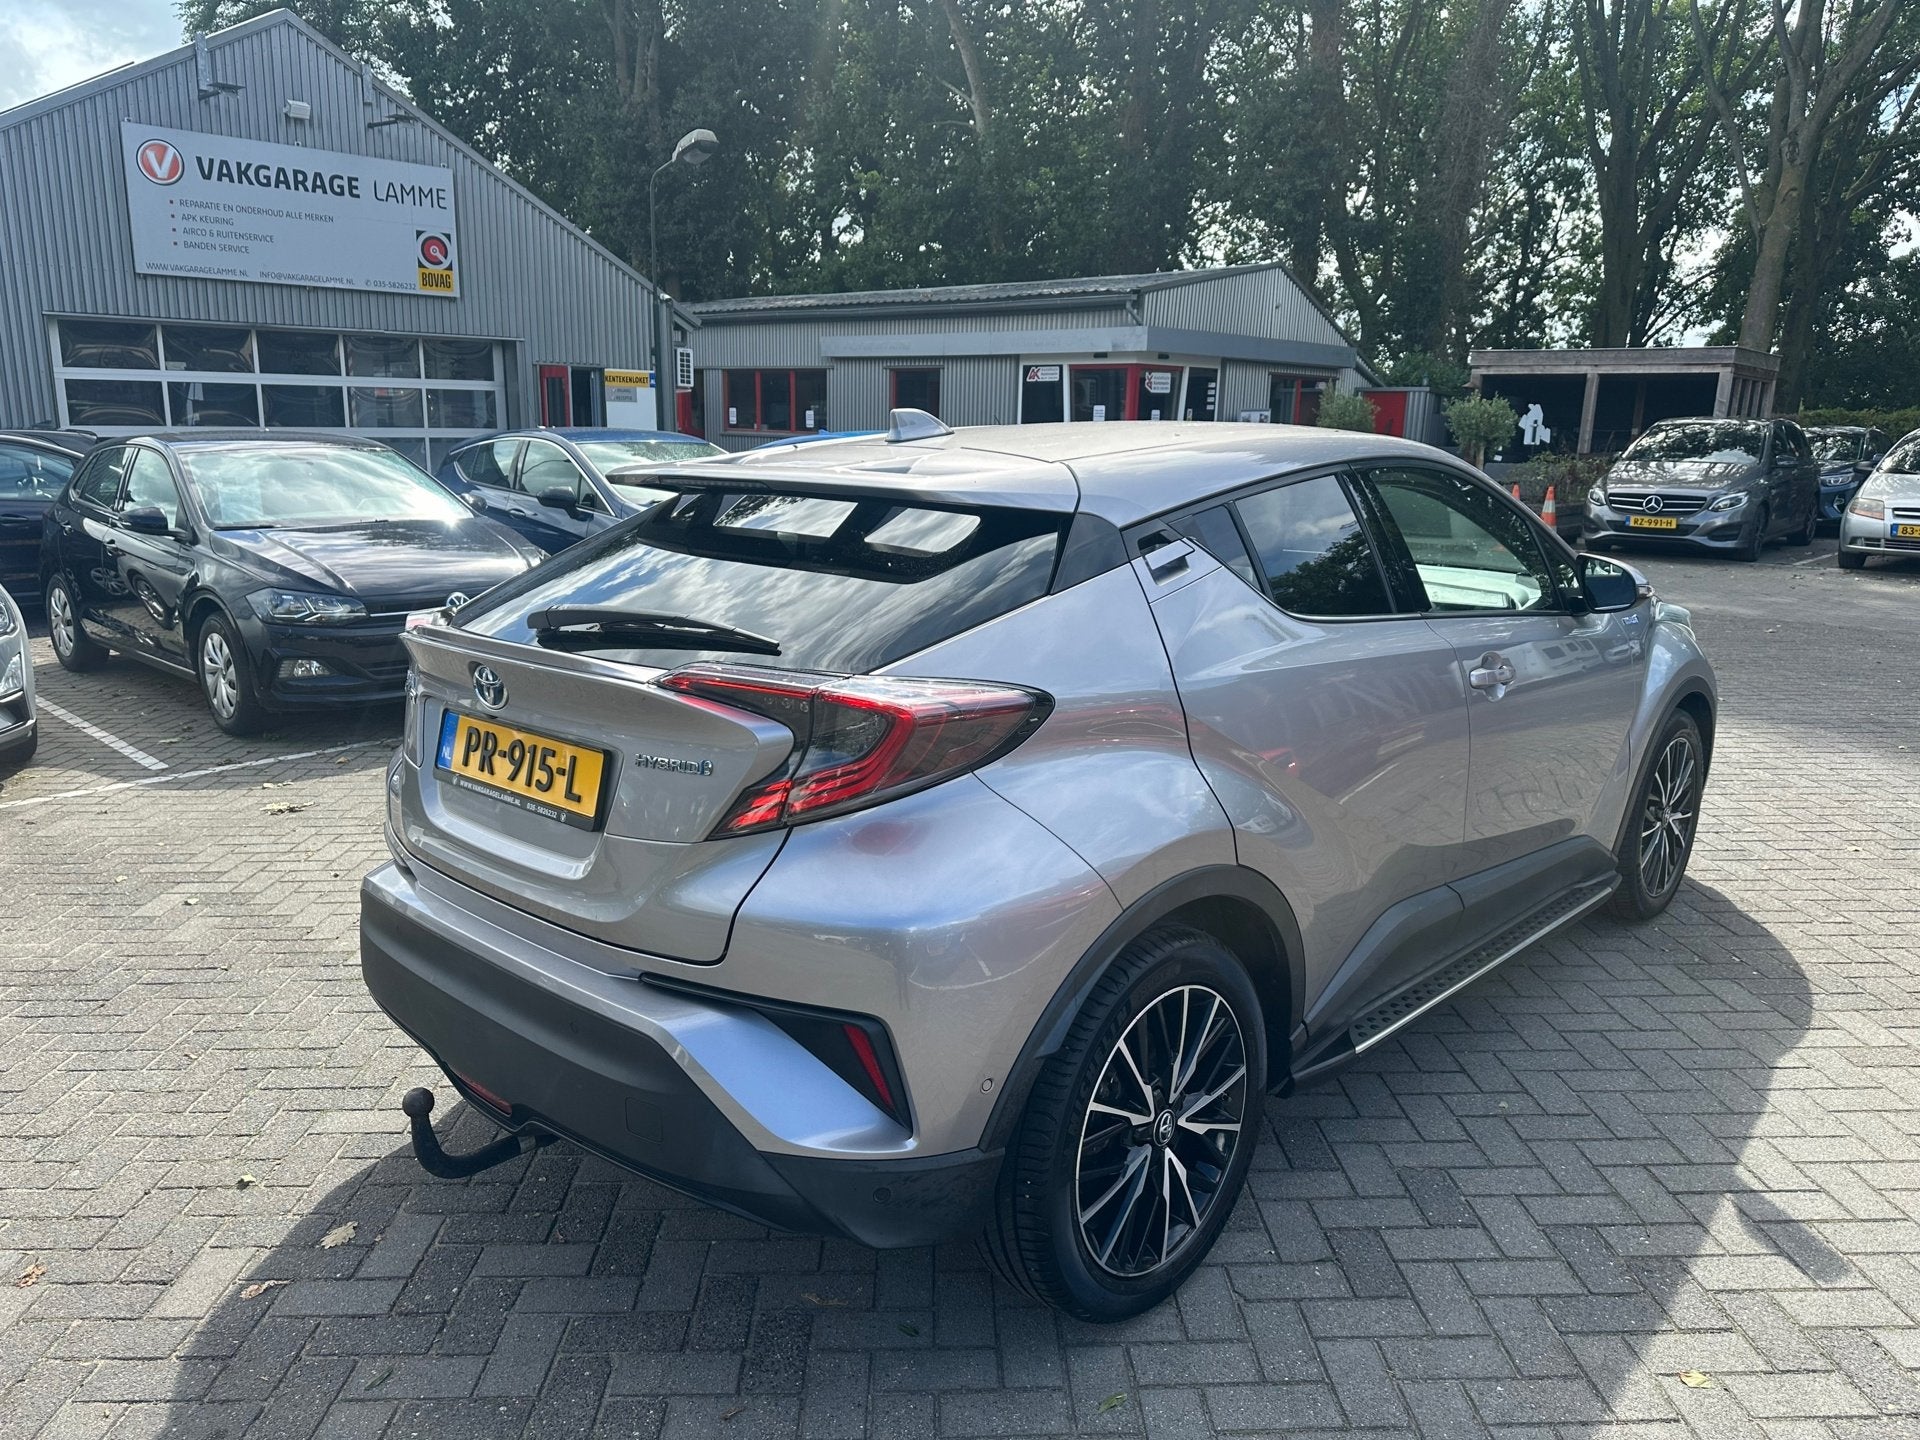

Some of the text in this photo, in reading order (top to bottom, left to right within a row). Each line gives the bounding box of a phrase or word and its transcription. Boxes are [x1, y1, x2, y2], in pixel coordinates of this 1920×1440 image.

[195, 156, 448, 210] VAKGARAGE LAMME
[179, 198, 334, 223] REPARATIE EN ONDERHOUD ALLE MERKEN
[181, 213, 234, 226] APK KEURING
[182, 226, 207, 237] AIRCO
[216, 230, 275, 244] RUITENSERVICE
[183, 240, 250, 254] BANDEN SERVICE
[145, 262, 417, 291] WWW.VAKGARAGELAMME.NL INFO@VAKGARAGELAMME.NL 035-5826232
[421, 271, 452, 289] BOVAG
[605, 375, 649, 384] KENTEKENLOKET
[1633, 517, 1673, 527] RZ-991-H
[441, 746, 452, 761] NL
[461, 725, 582, 803] PR-915-L
[635, 753, 701, 775] HYBRID
